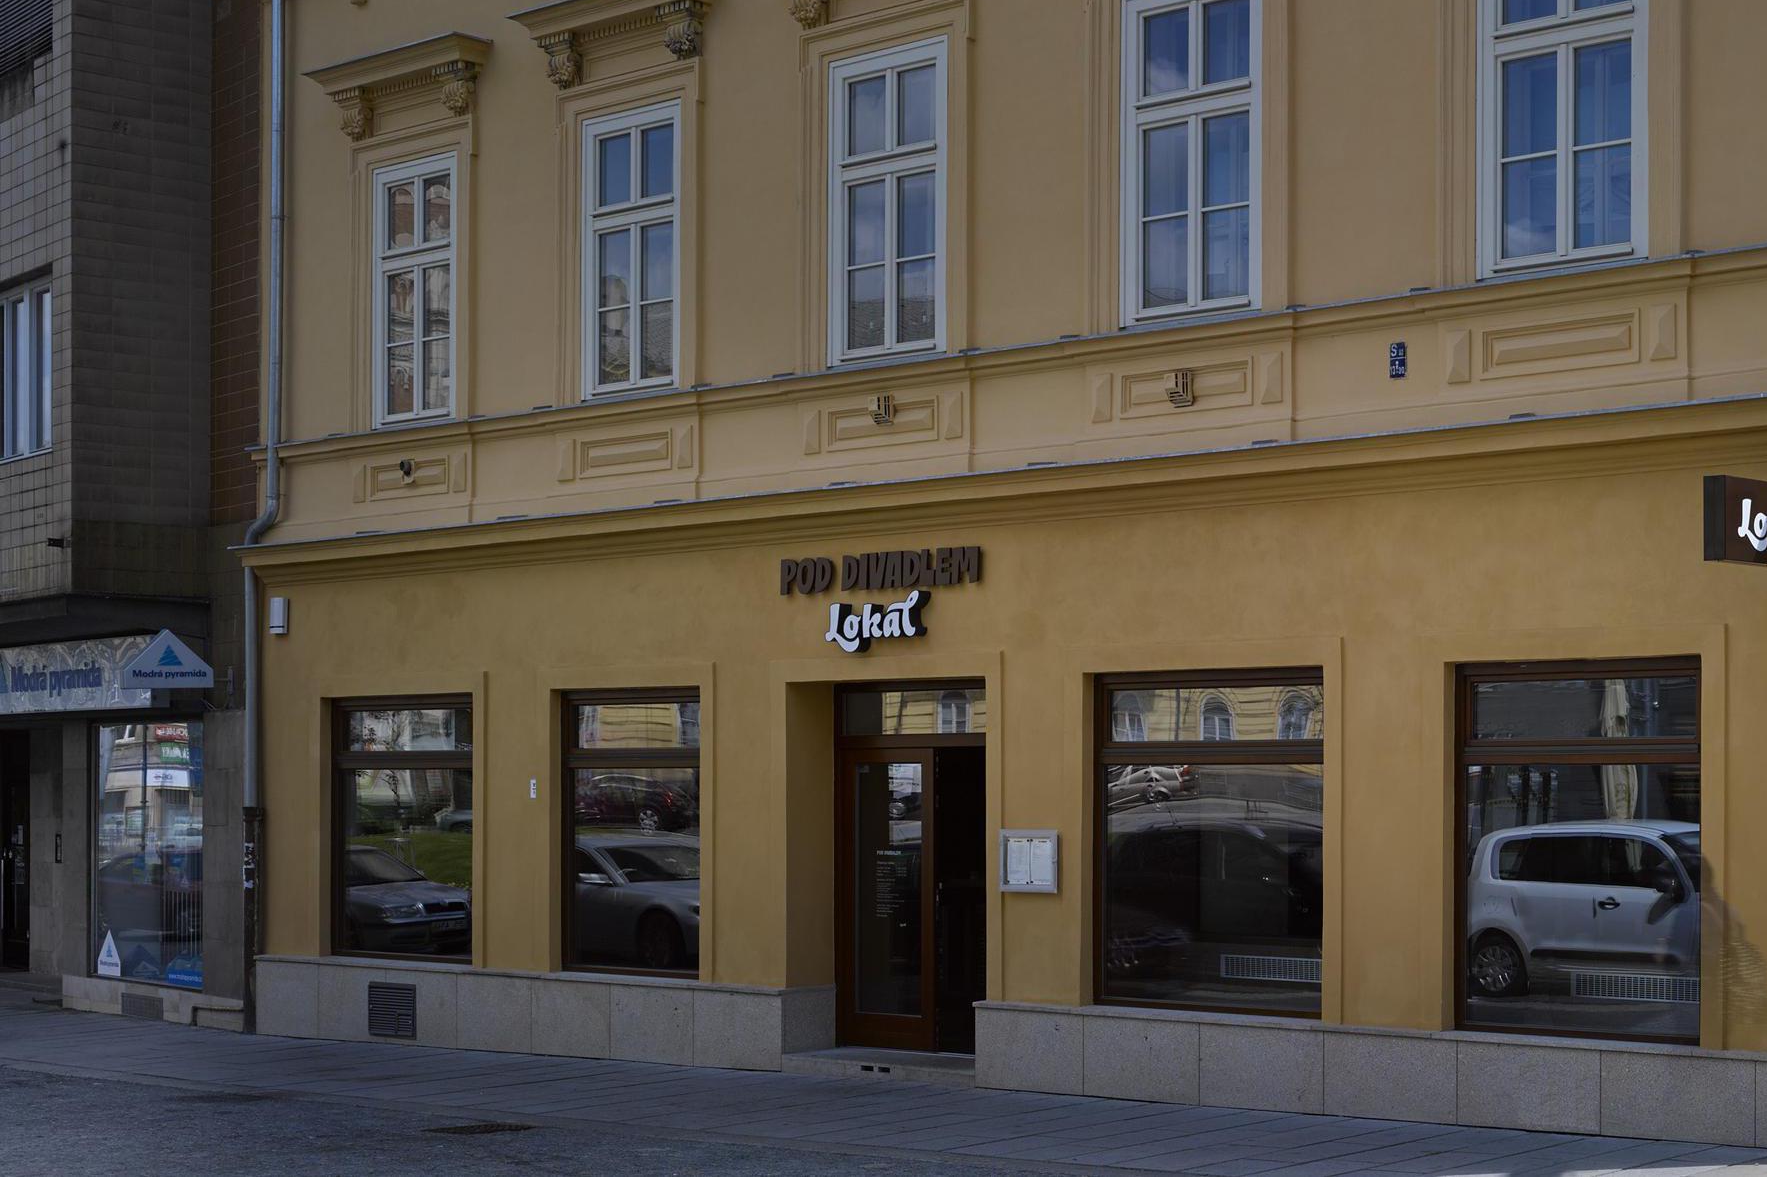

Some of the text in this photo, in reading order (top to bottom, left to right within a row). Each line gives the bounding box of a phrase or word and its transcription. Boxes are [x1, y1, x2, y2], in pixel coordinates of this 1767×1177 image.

[780, 546, 981, 596] POD DIVADLEM
[11, 660, 102, 698] Modrá pyramida
[132, 668, 207, 680] Modrá pyramida
